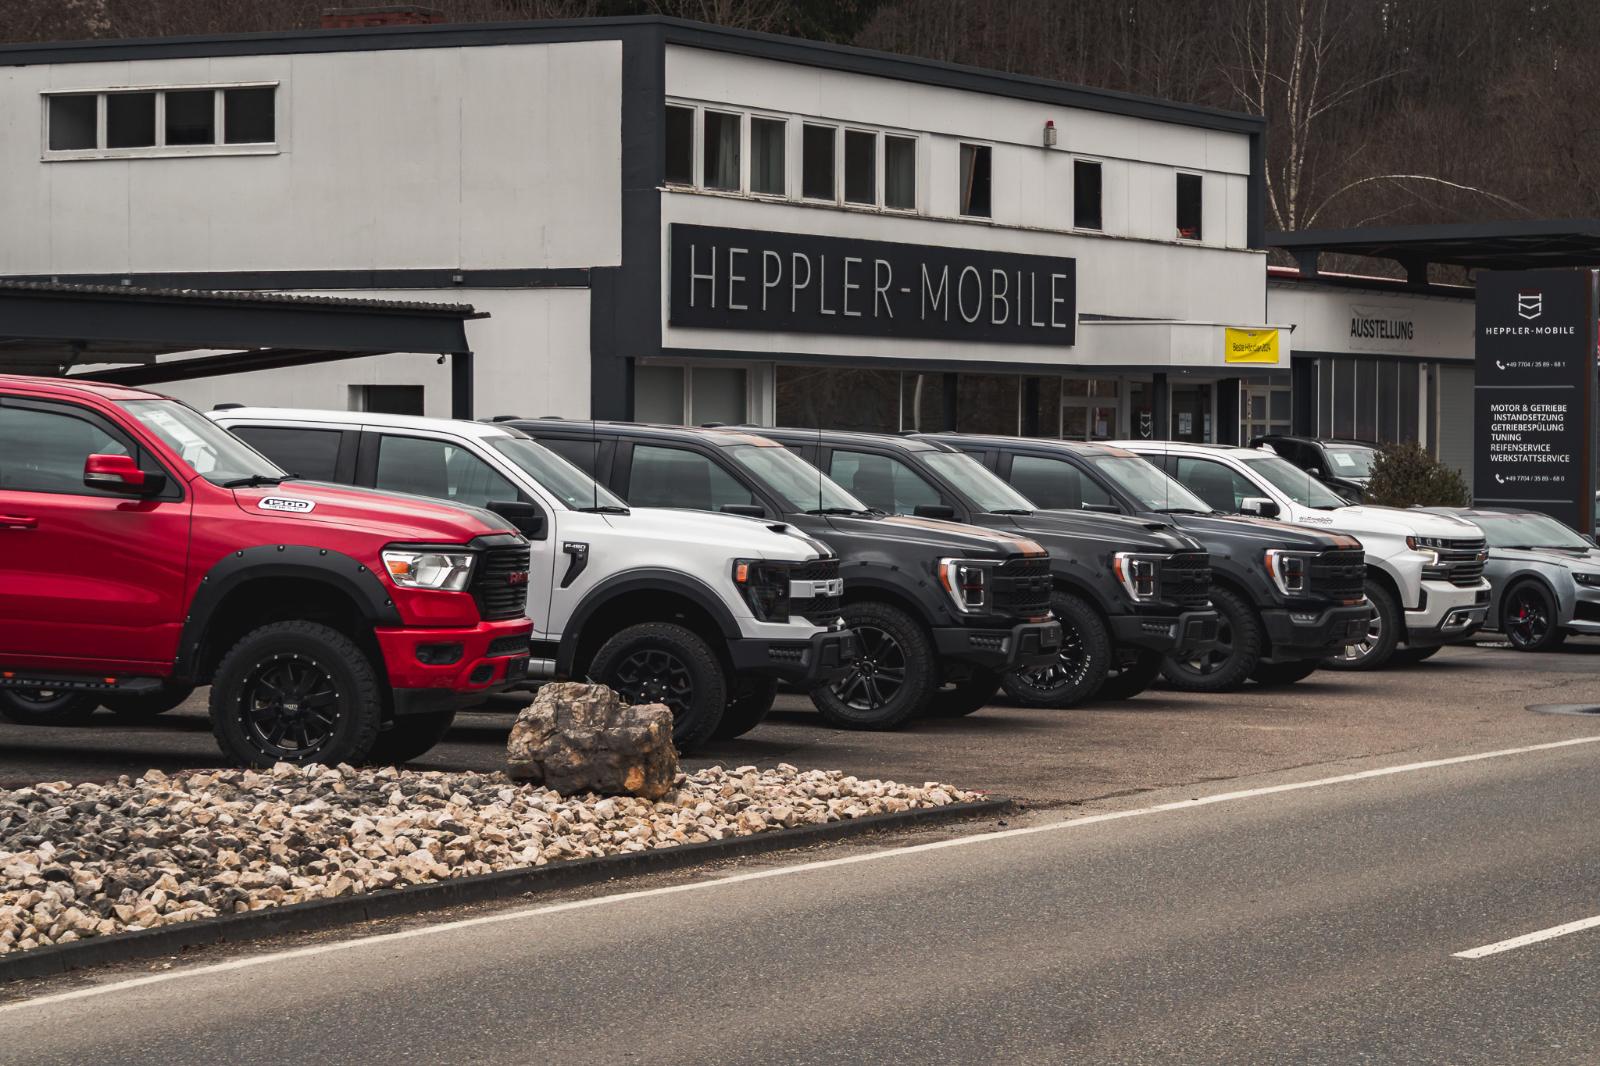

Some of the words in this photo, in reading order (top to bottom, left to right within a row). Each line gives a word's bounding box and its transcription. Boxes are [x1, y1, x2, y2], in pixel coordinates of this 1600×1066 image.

[690, 243, 1067, 328] HEPPLER-MOBILE
[1350, 317, 1414, 340] AUSSTELLUNG
[1485, 326, 1575, 335] HEPPLER-MOBILE
[1490, 404, 1521, 412] MOTOR
[1522, 404, 1529, 412] &
[1530, 404, 1567, 412] GETRIEBE
[1494, 413, 1564, 422] INSTANDSETZUNG
[1491, 422, 1564, 432] GETRIEBESPÜLUNG
[1491, 433, 1522, 441] TUNING
[1490, 443, 1551, 452] REIFENSERVICE
[1490, 454, 1570, 463] WERKSTATTSERVICE
[268, 499, 307, 508] 1500
